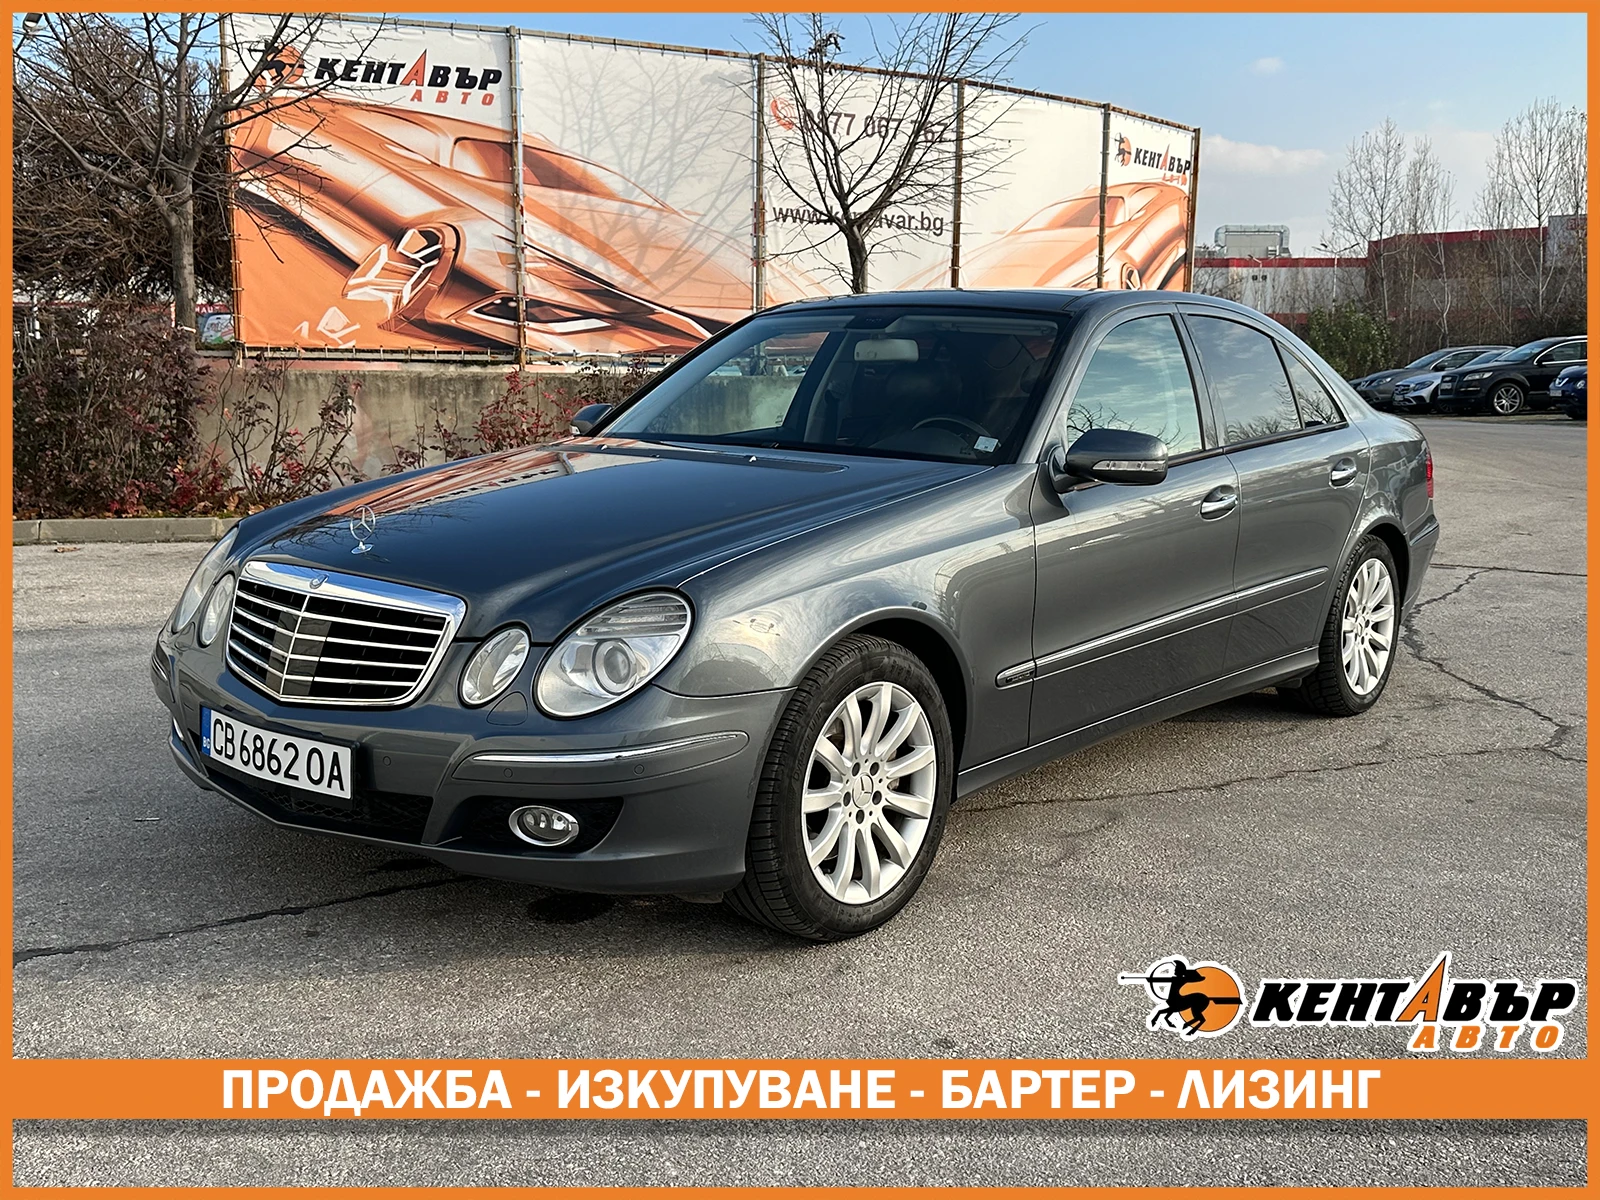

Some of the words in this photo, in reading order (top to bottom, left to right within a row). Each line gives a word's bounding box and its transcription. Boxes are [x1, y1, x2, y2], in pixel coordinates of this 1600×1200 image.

[315, 49, 503, 91] КЕНТАВЪР
[410, 89, 495, 106] АВТО
[1133, 143, 1191, 175] КЕНТАВЪР
[202, 736, 211, 749] BG
